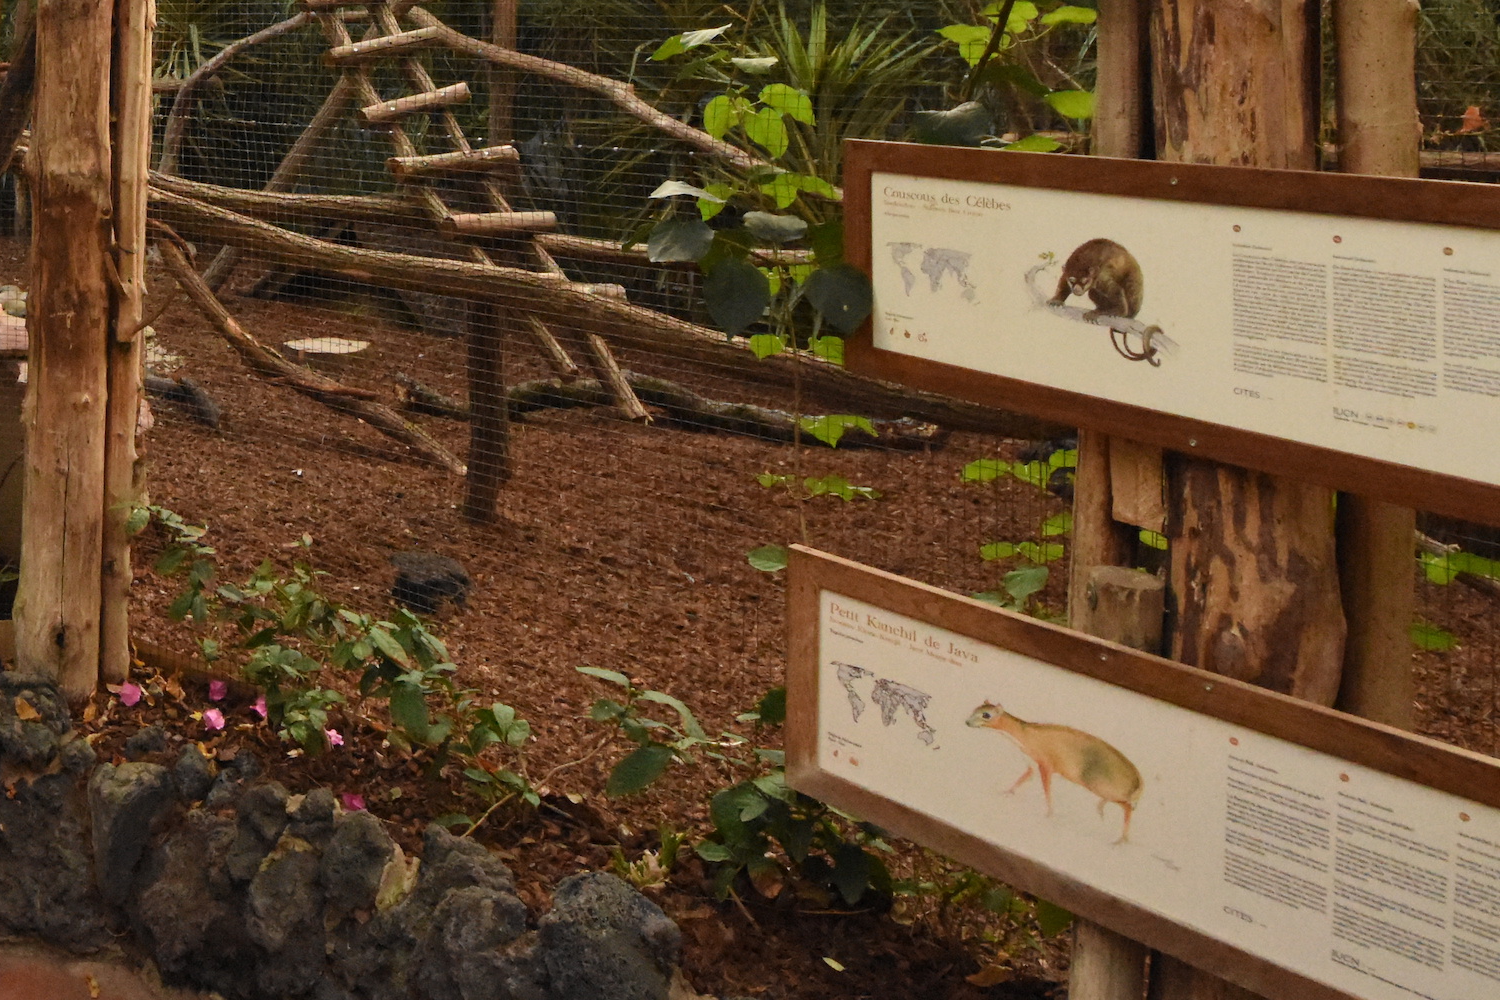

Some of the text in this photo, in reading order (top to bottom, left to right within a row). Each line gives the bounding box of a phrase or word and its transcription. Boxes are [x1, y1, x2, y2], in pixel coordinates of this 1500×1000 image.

[883, 186, 936, 202] Couscous
[941, 193, 960, 205] des
[966, 194, 1011, 211] Célèbes
[1233, 387, 1260, 399] CITES
[830, 602, 859, 622] Petit
[867, 614, 917, 643] Kanchil
[924, 635, 941, 650] de
[948, 642, 978, 664] Java
